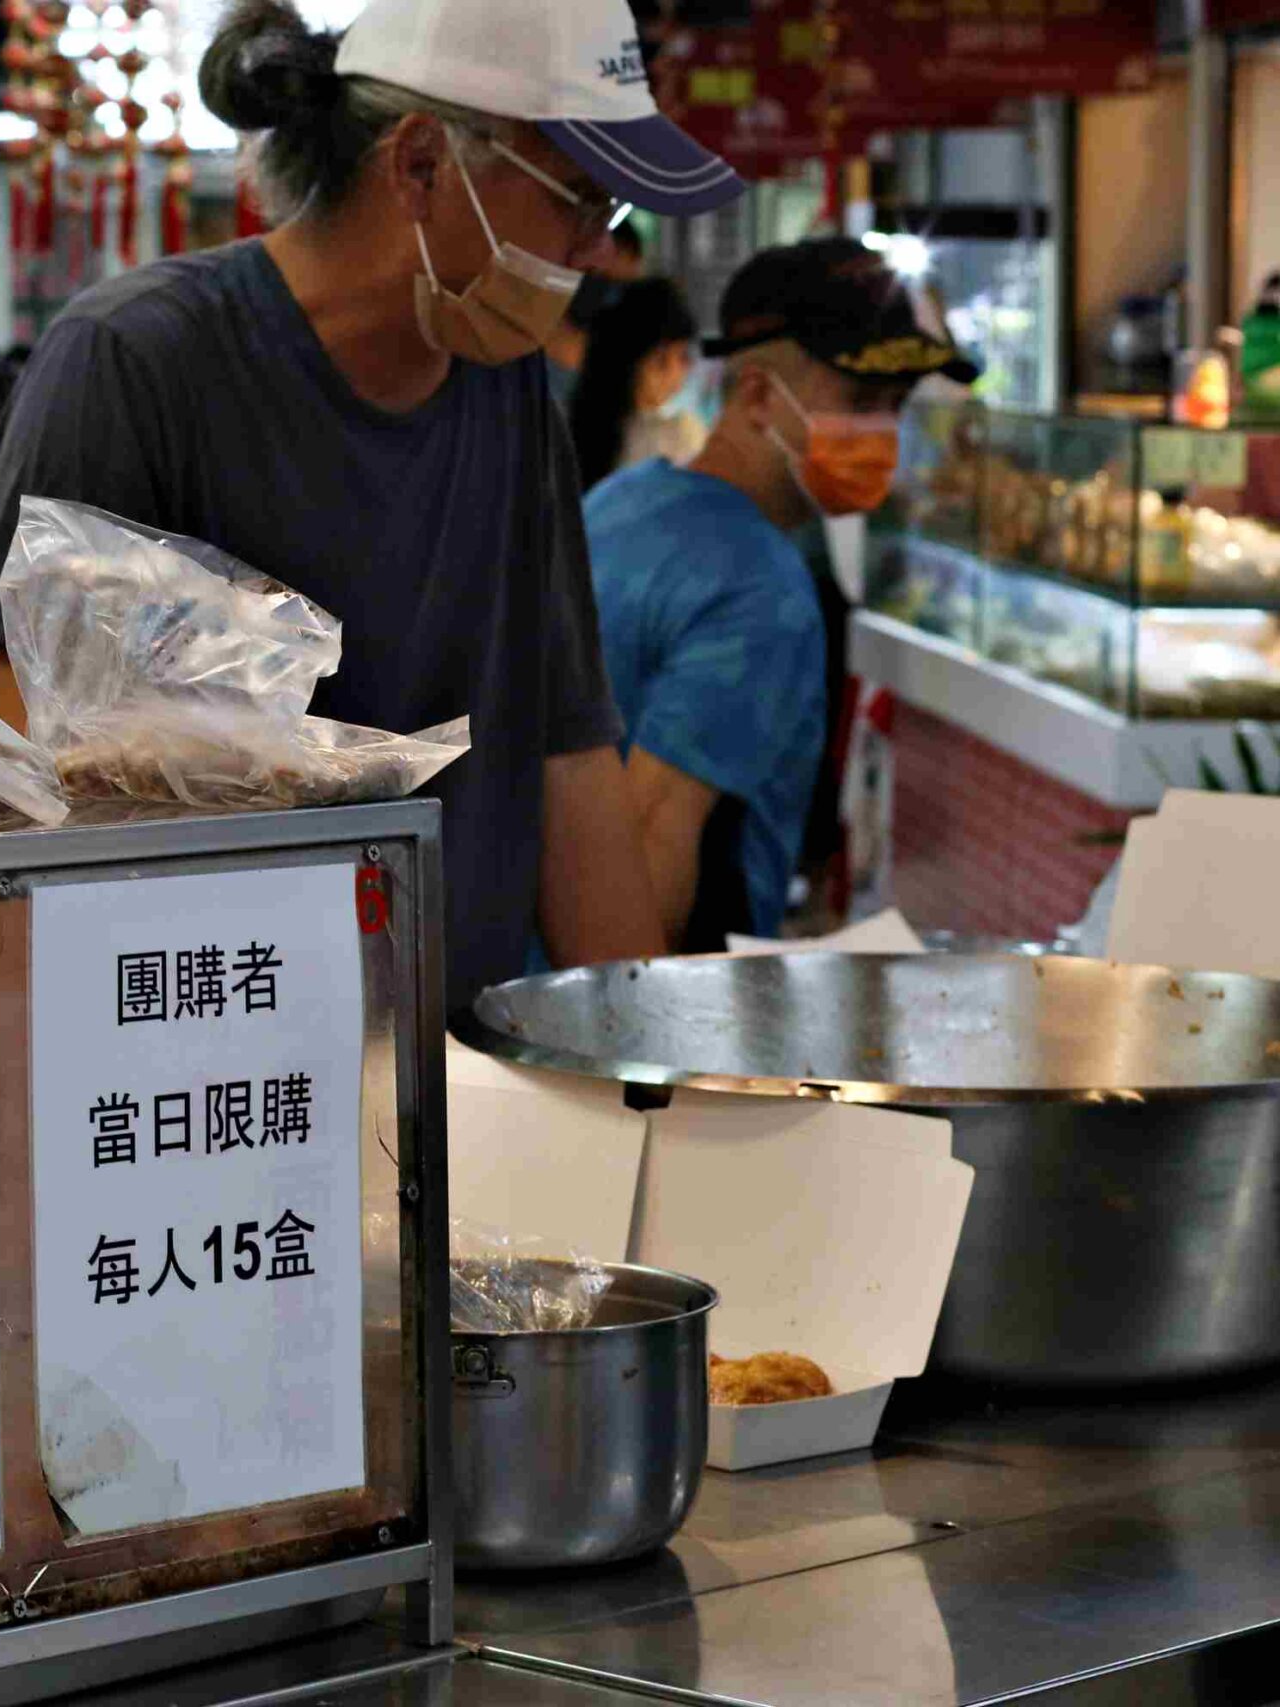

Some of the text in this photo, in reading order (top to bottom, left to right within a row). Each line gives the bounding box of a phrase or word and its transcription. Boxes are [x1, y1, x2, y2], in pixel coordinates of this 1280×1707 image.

[117, 940, 283, 1027] 團購者
[88, 1071, 313, 1169] 當日限購
[87, 1208, 316, 1305] 每人15盒
